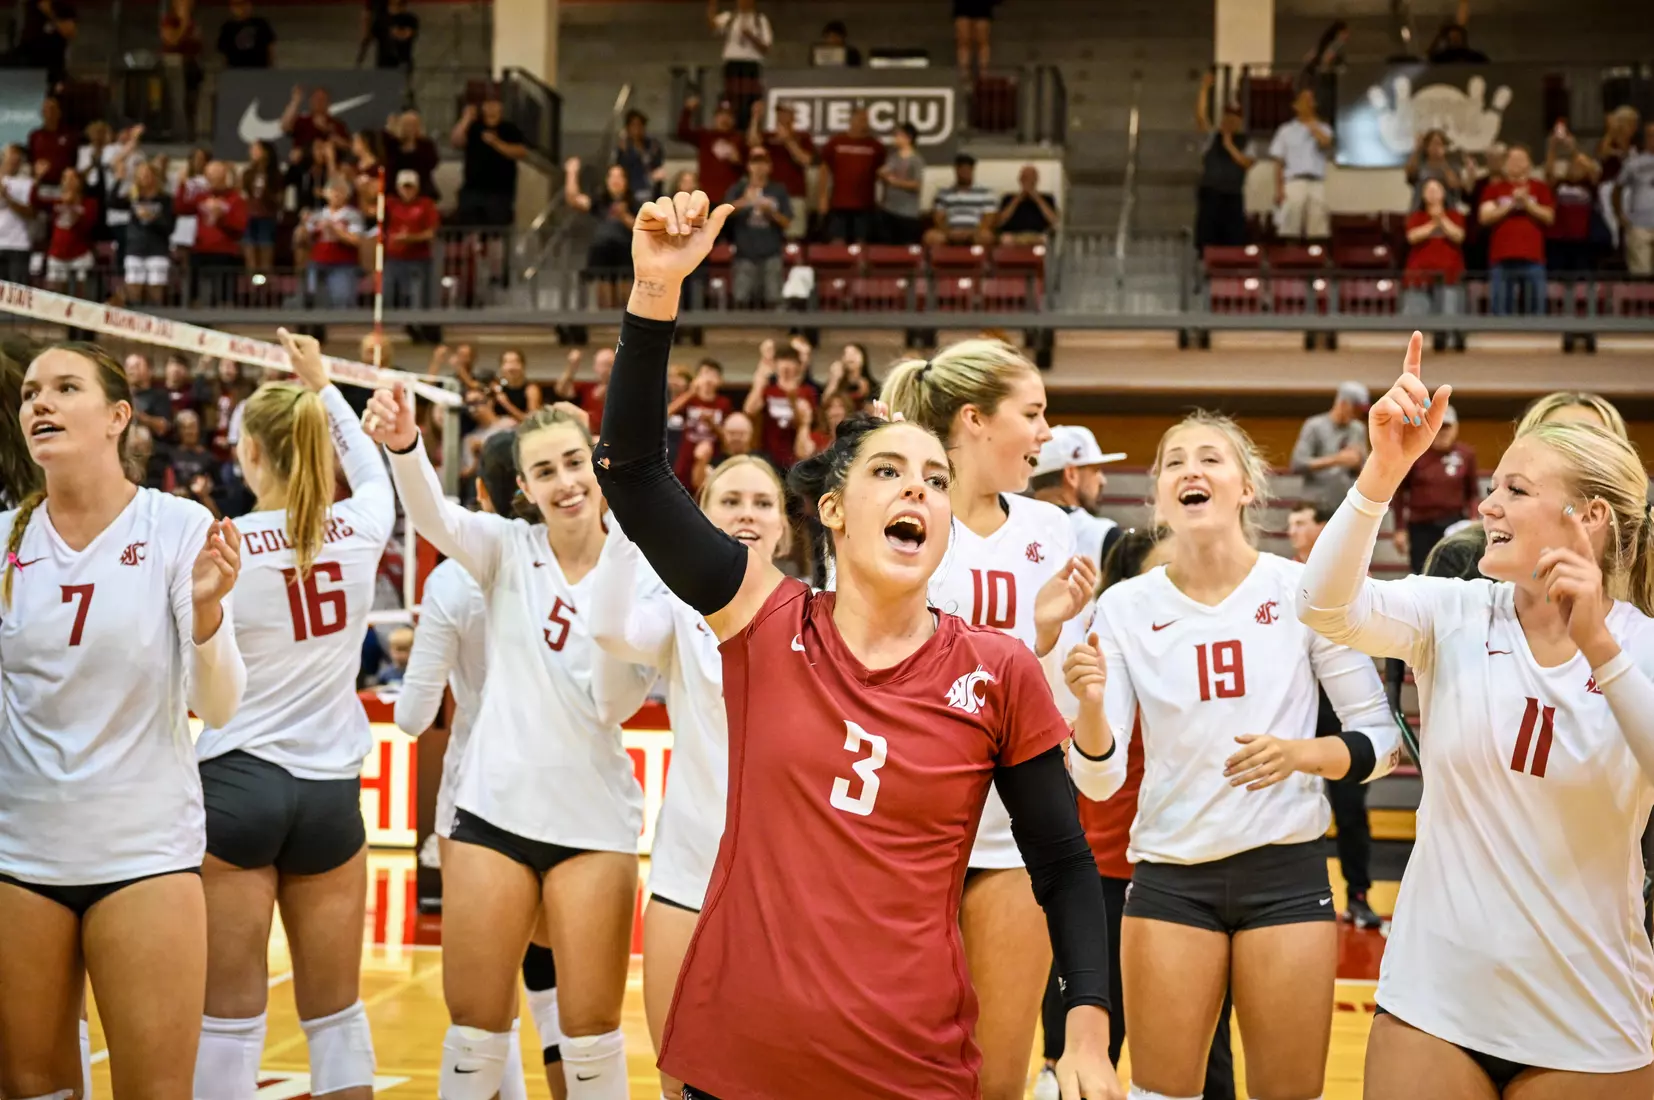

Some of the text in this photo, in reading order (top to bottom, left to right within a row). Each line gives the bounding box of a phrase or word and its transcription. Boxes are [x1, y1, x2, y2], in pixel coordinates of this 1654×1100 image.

[59, 582, 95, 647] 7
[281, 561, 348, 642] 16
[543, 595, 577, 652] 5
[969, 567, 1017, 630] 10
[1193, 639, 1246, 702] 19
[829, 719, 888, 816] 3
[1510, 696, 1556, 779] 11
